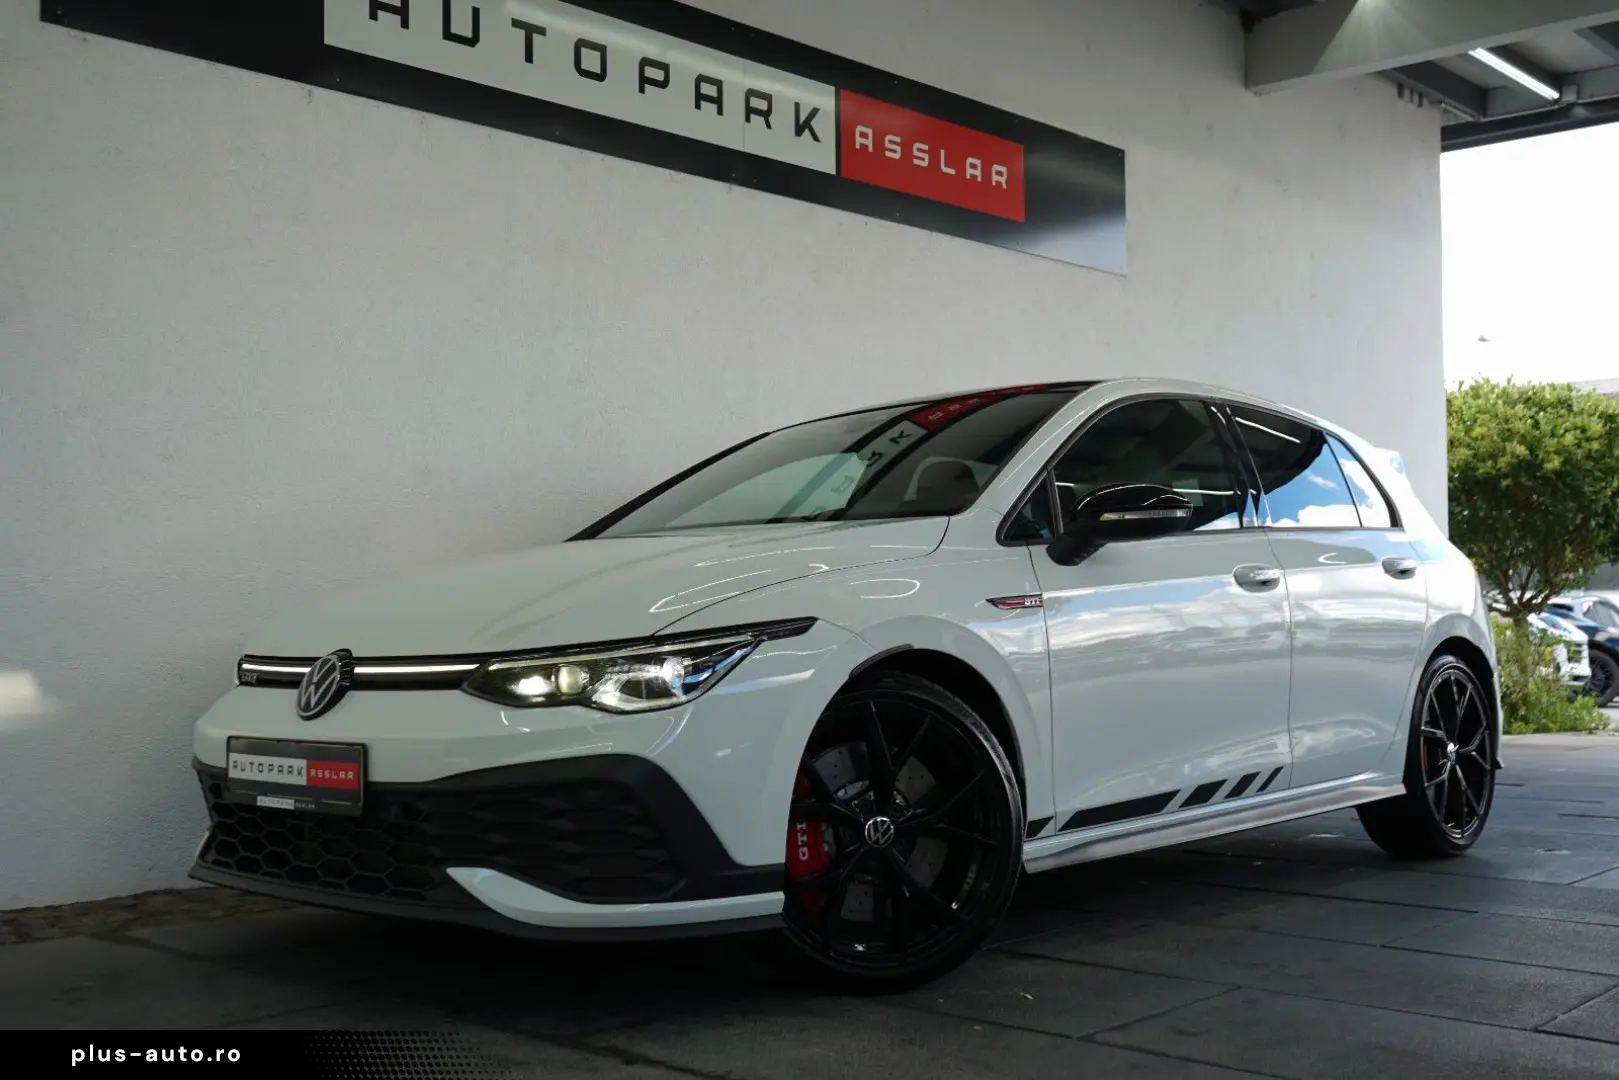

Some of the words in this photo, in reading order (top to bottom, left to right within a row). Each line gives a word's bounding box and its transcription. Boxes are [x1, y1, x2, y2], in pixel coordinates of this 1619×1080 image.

[855, 125, 1008, 189] ASSLAR
[232, 760, 304, 778] AUTOPARK
[310, 768, 354, 781] ASSLAR
